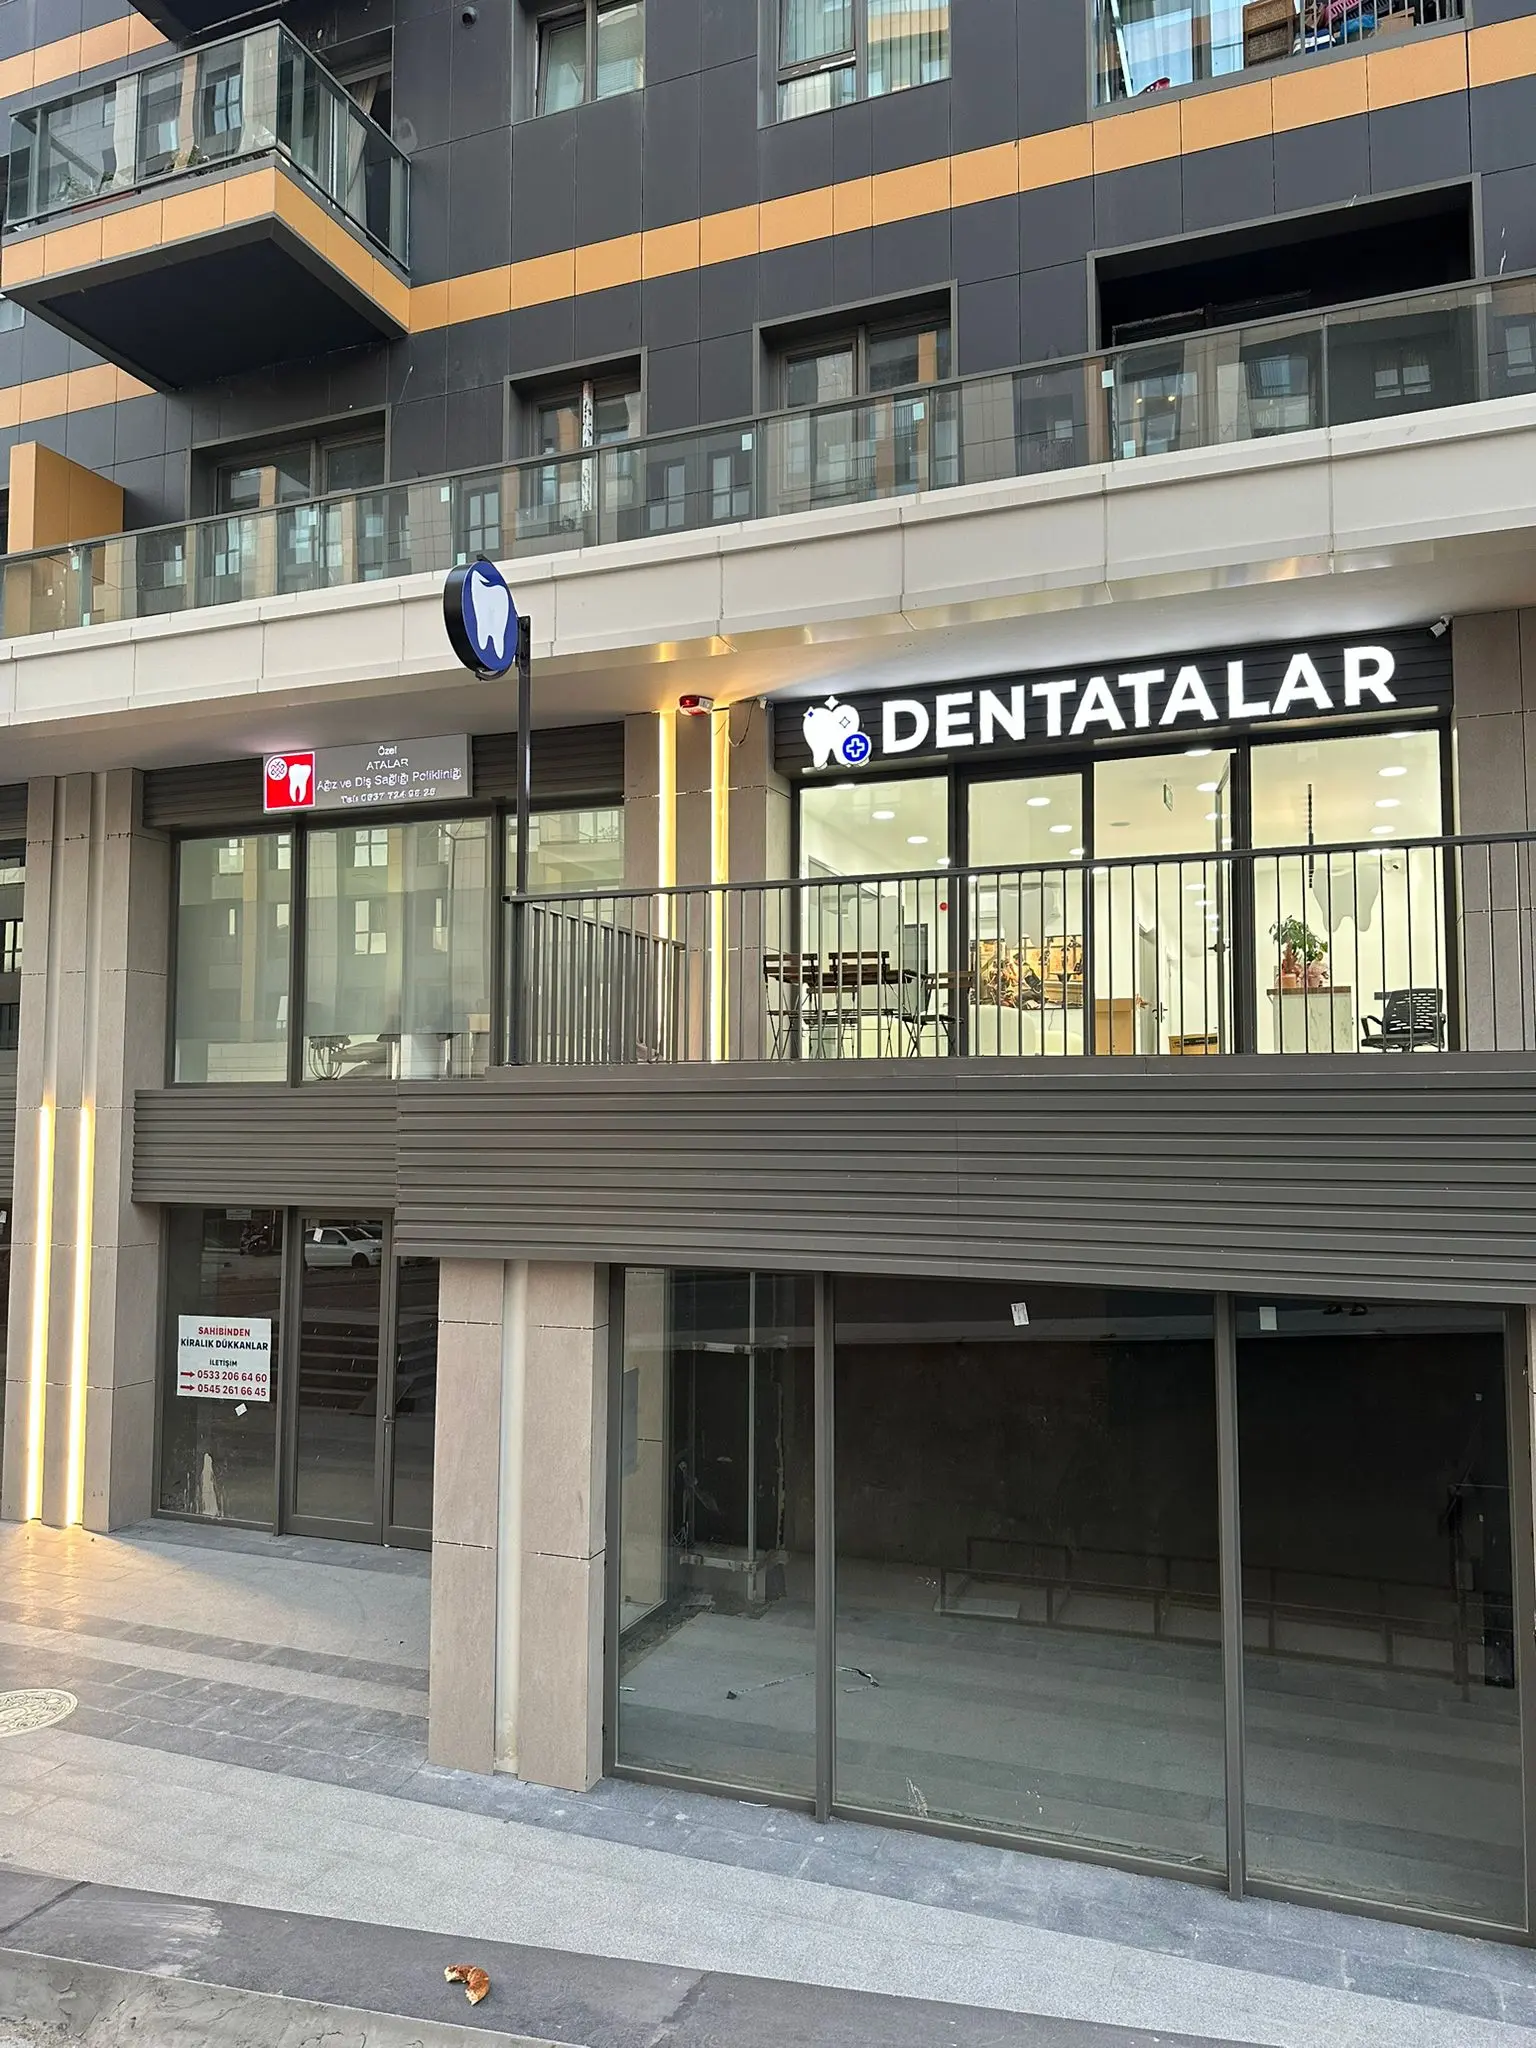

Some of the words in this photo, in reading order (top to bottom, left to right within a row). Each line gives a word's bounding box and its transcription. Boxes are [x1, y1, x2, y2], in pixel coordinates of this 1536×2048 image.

[881, 645, 1397, 755] DENTATALAR
[377, 745, 398, 756] Özel
[366, 758, 409, 771] ATALAR
[316, 780, 338, 793] Ağız
[341, 778, 351, 788] ve
[355, 776, 371, 789] Diş
[374, 773, 409, 787] Sağlığı
[412, 767, 462, 782] Polikliniği
[198, 1325, 251, 1337] SAHİBİNDEN
[180, 1337, 214, 1348] KİRALIK
[215, 1338, 269, 1351] DÜKKANLAR
[209, 1358, 238, 1368] İLETİŞİM
[197, 1370, 220, 1380] 0533
[222, 1371, 239, 1381] 206
[241, 1372, 253, 1382] 64
[255, 1373, 268, 1383] 60
[197, 1383, 221, 1394] 0545
[222, 1385, 239, 1395] 261
[240, 1386, 253, 1396] 66
[254, 1387, 267, 1397] 45
